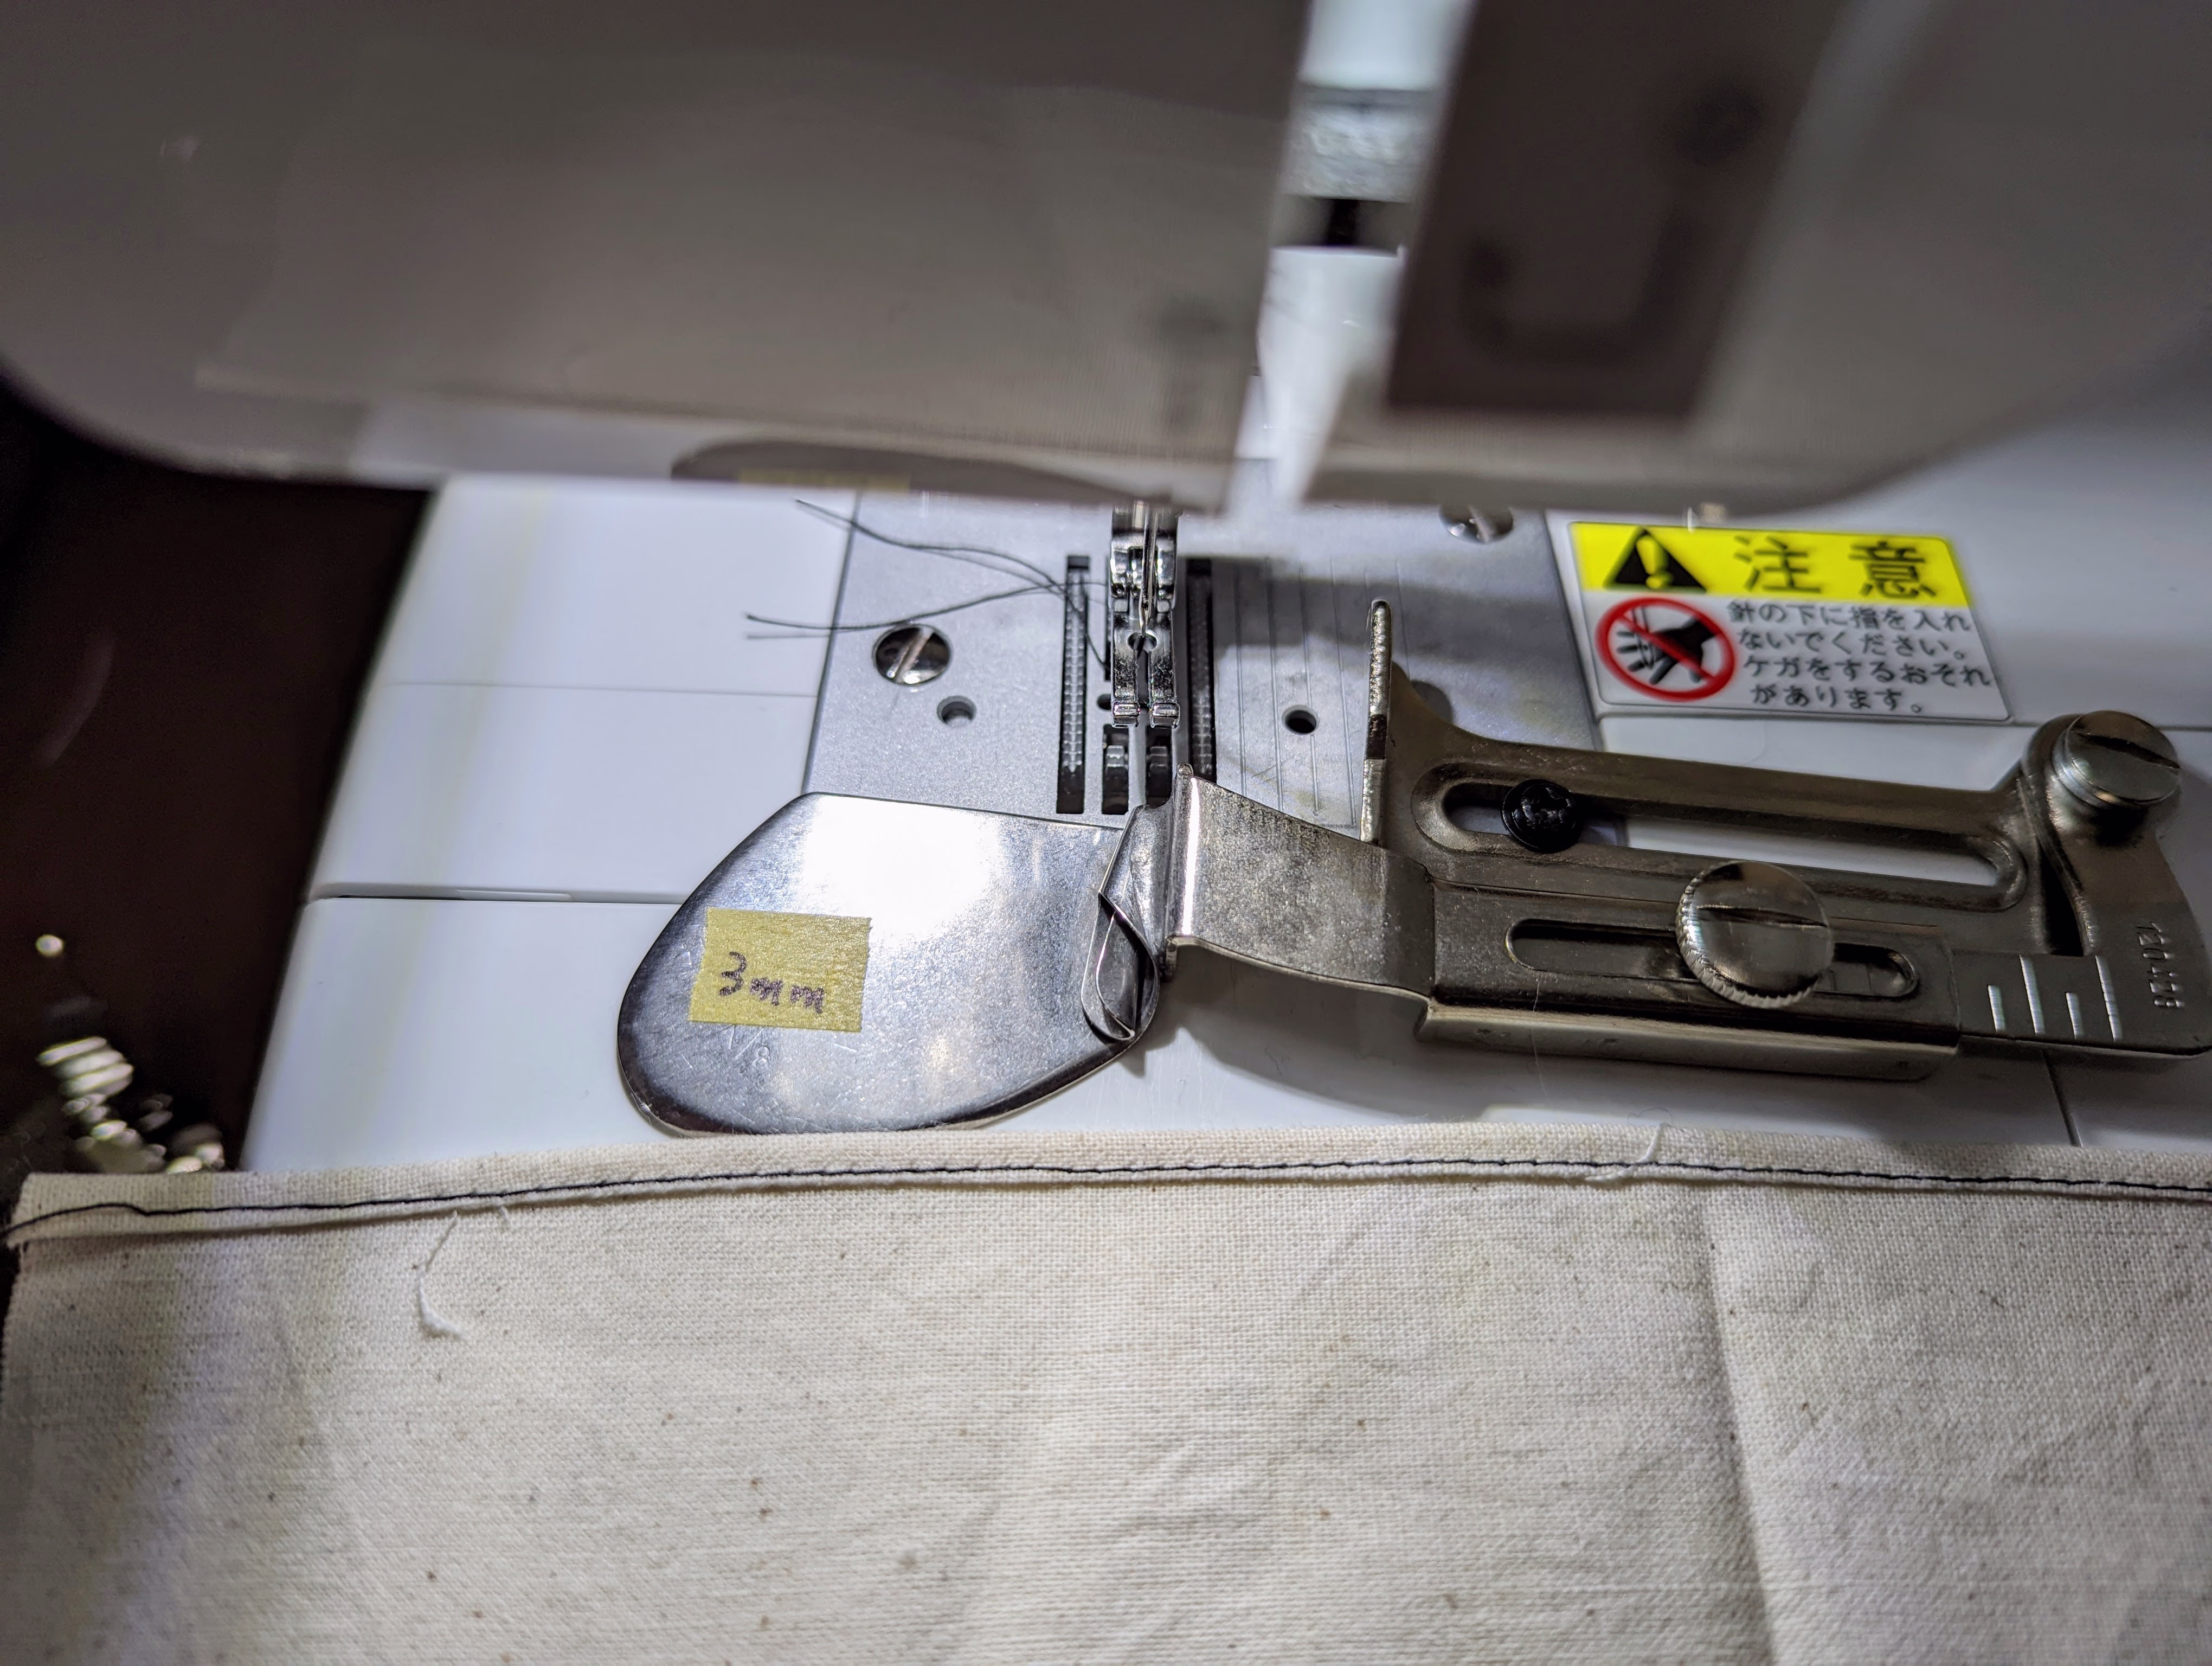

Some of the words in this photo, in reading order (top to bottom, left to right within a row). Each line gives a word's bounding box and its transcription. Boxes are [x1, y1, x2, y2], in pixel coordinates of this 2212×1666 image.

[1733, 535, 1937, 598] 注意
[1728, 600, 1970, 632] 針の下に指を入れ
[1737, 628, 1965, 661] ないでください。
[1743, 655, 1991, 687] ケガをするおそれ
[1750, 683, 1922, 713] があります。
[719, 951, 825, 1014] 3mm
